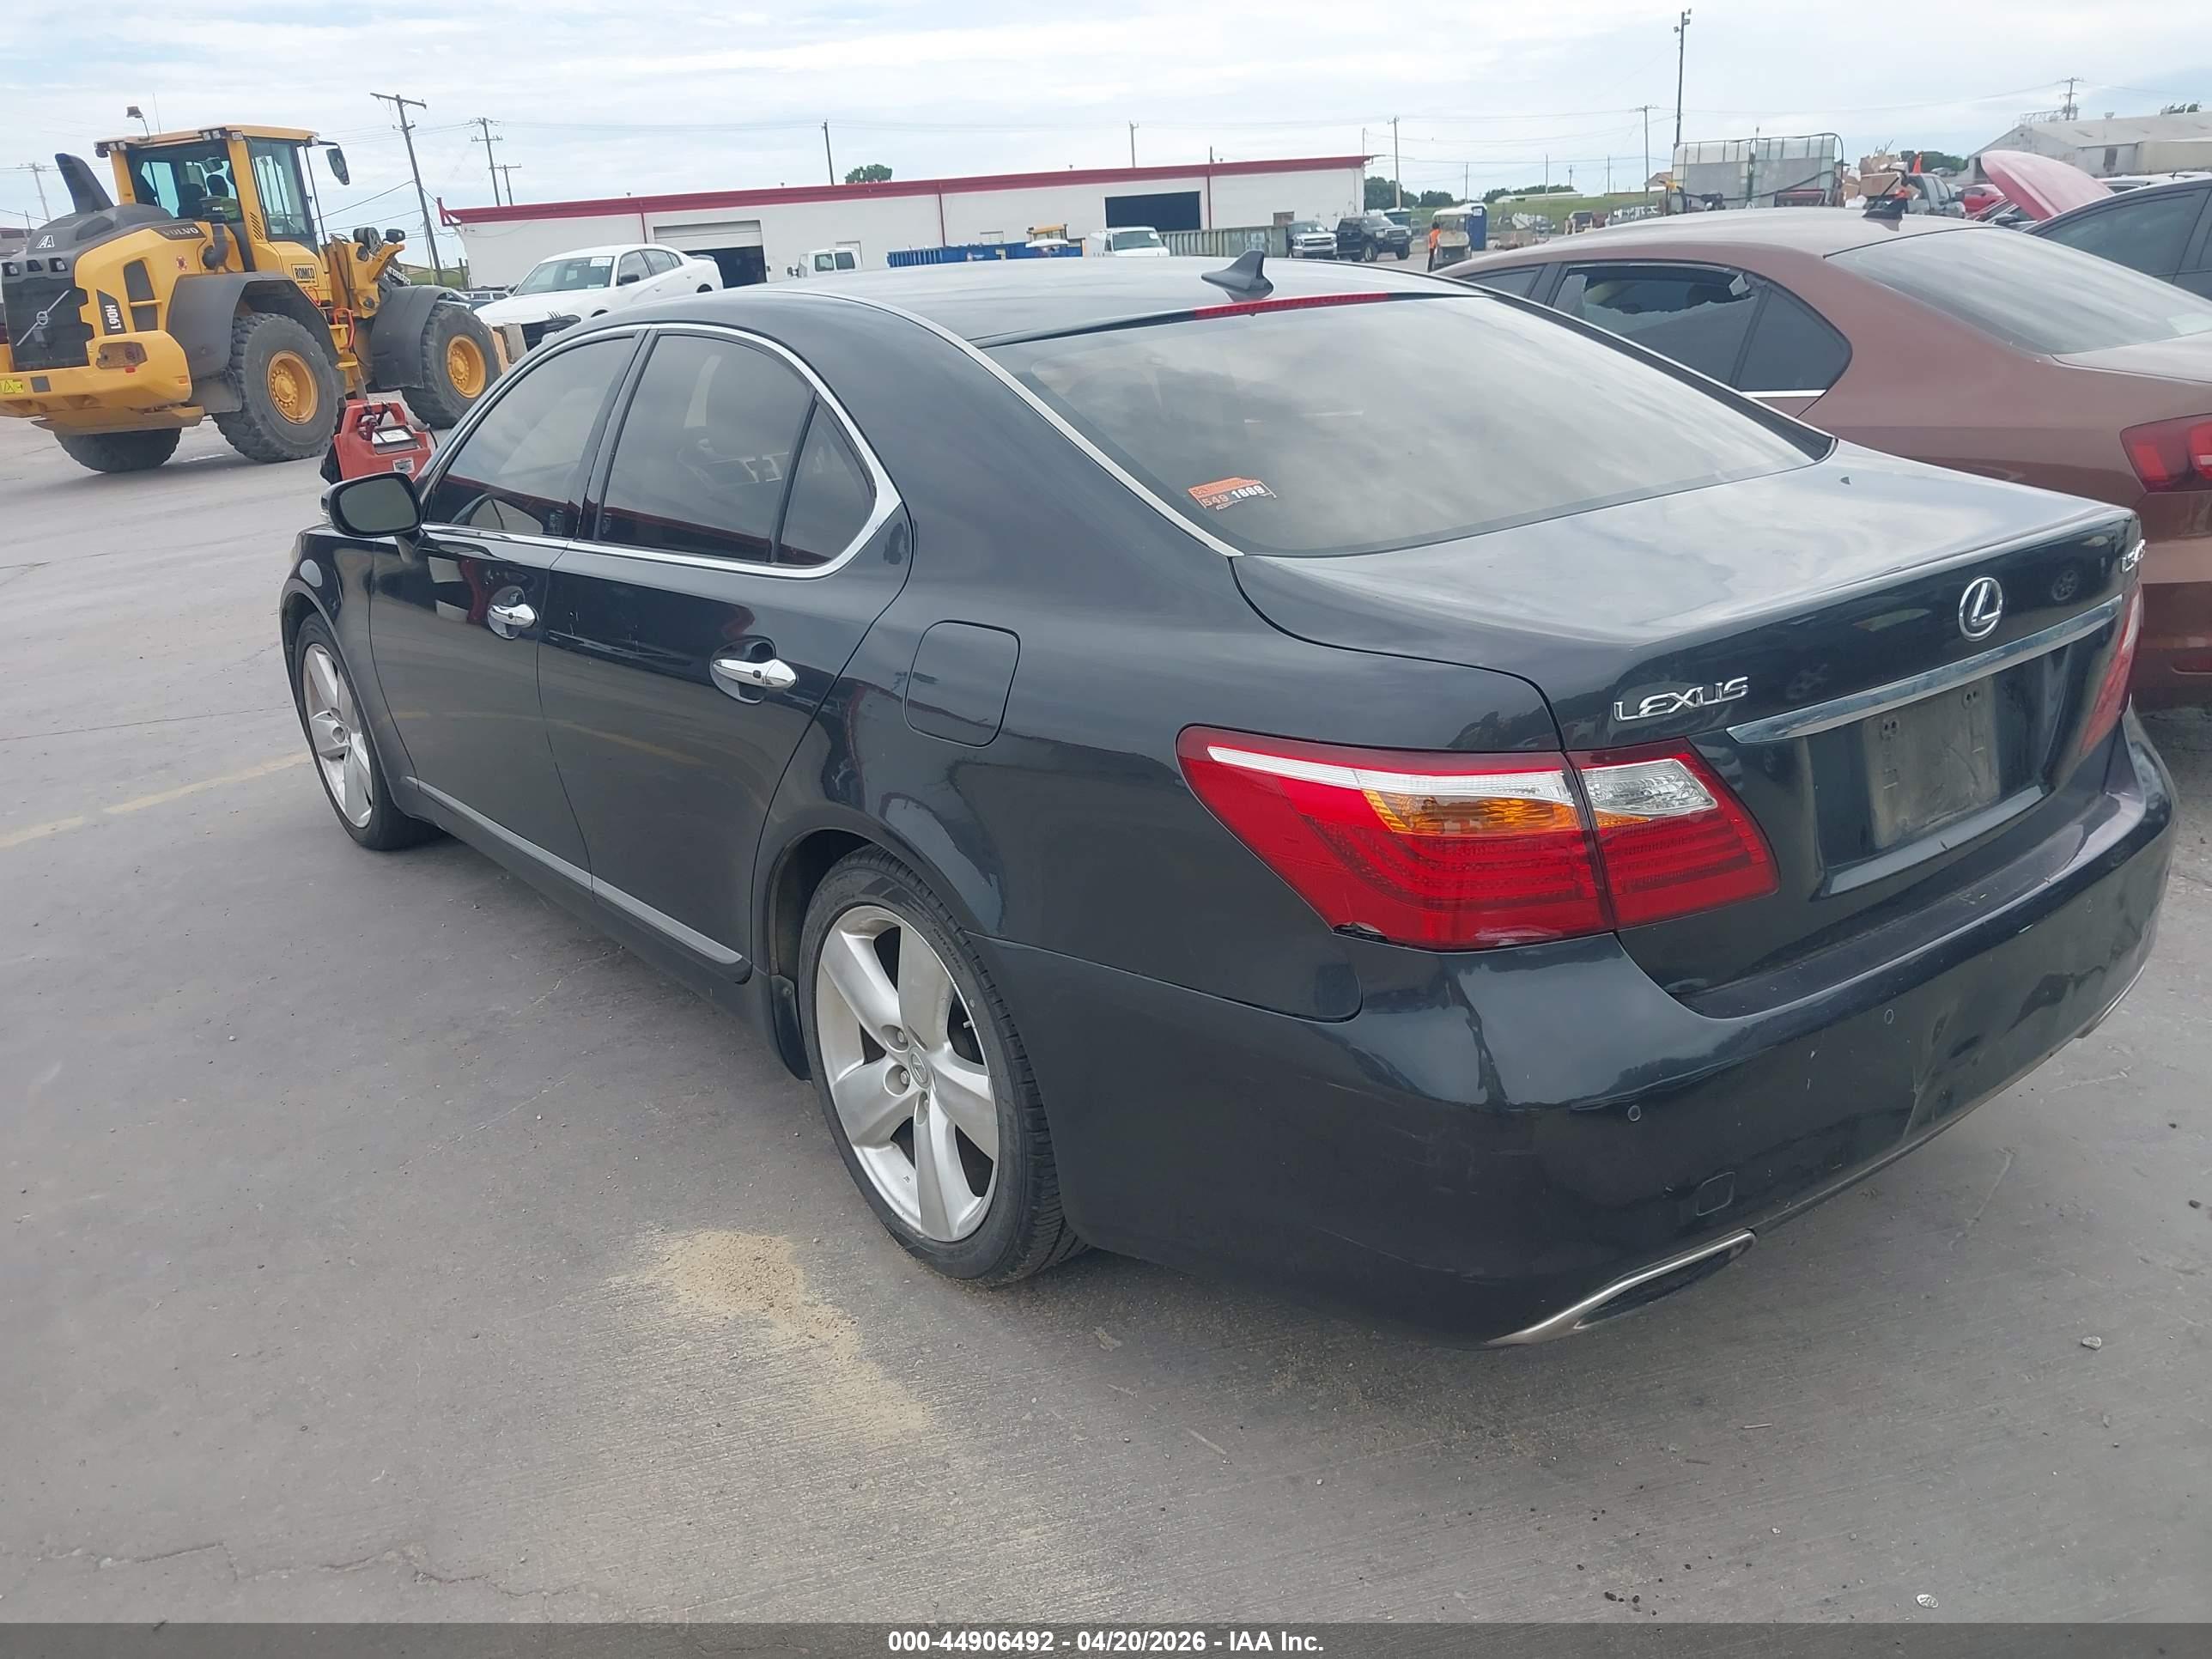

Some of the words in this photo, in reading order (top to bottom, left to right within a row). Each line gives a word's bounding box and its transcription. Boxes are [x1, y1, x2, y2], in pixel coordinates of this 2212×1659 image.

[294, 267, 315, 280] ROMCO
[105, 303, 122, 331] L90H
[1613, 676, 1749, 722] LEXUS
